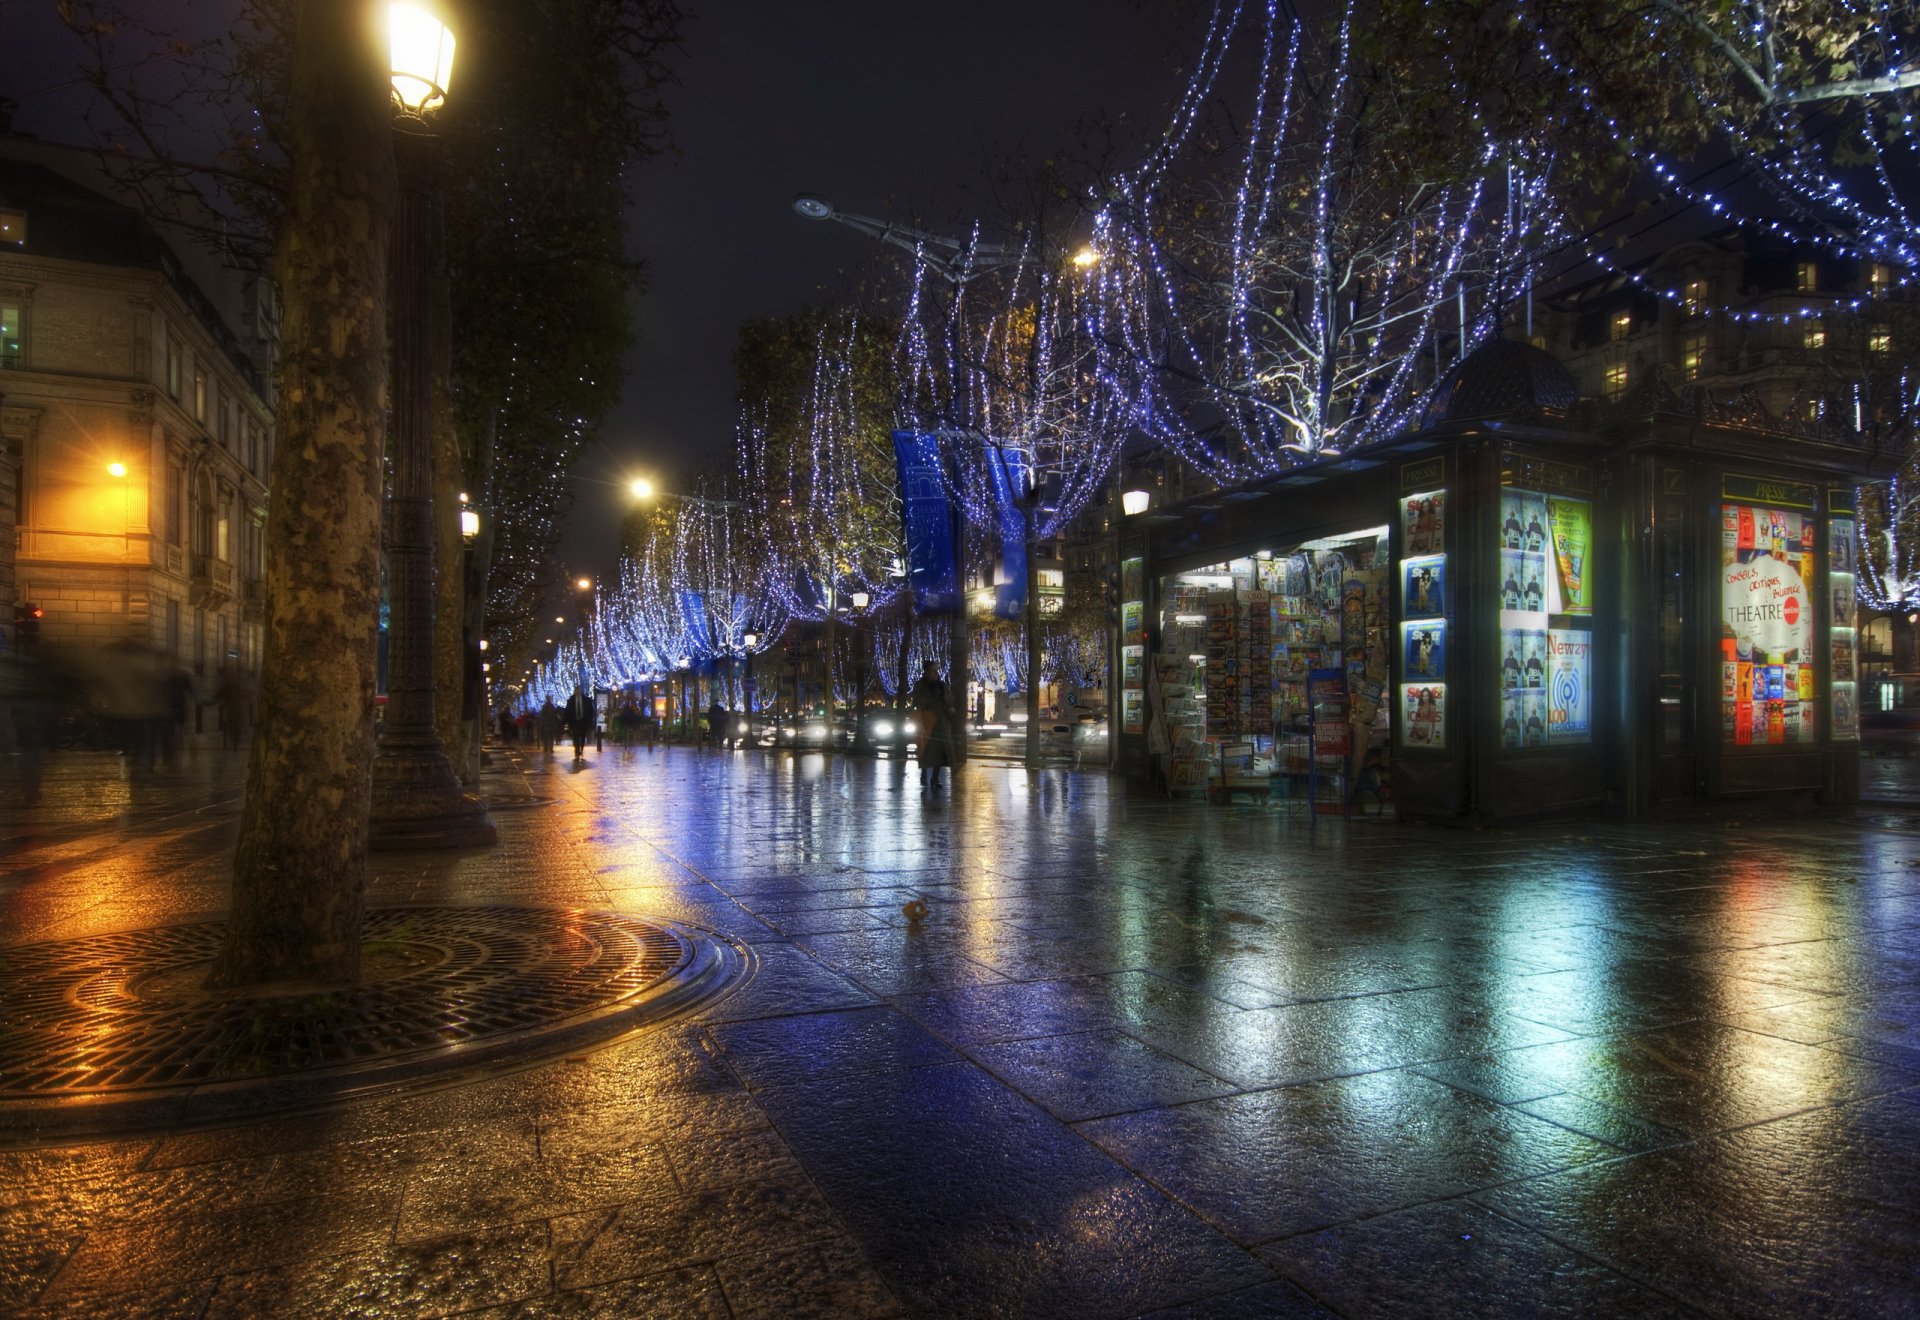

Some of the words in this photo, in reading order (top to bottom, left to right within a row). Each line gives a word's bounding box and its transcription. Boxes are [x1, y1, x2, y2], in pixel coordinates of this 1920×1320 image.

[1755, 482, 1788, 500] PRESSE
[1407, 496, 1443, 512] Stff
[1411, 567, 1441, 577] Stff
[1728, 604, 1782, 623] THEATRE
[1411, 630, 1441, 641] Stff
[1407, 687, 1444, 699] Stff
[1547, 709, 1567, 723] 100
